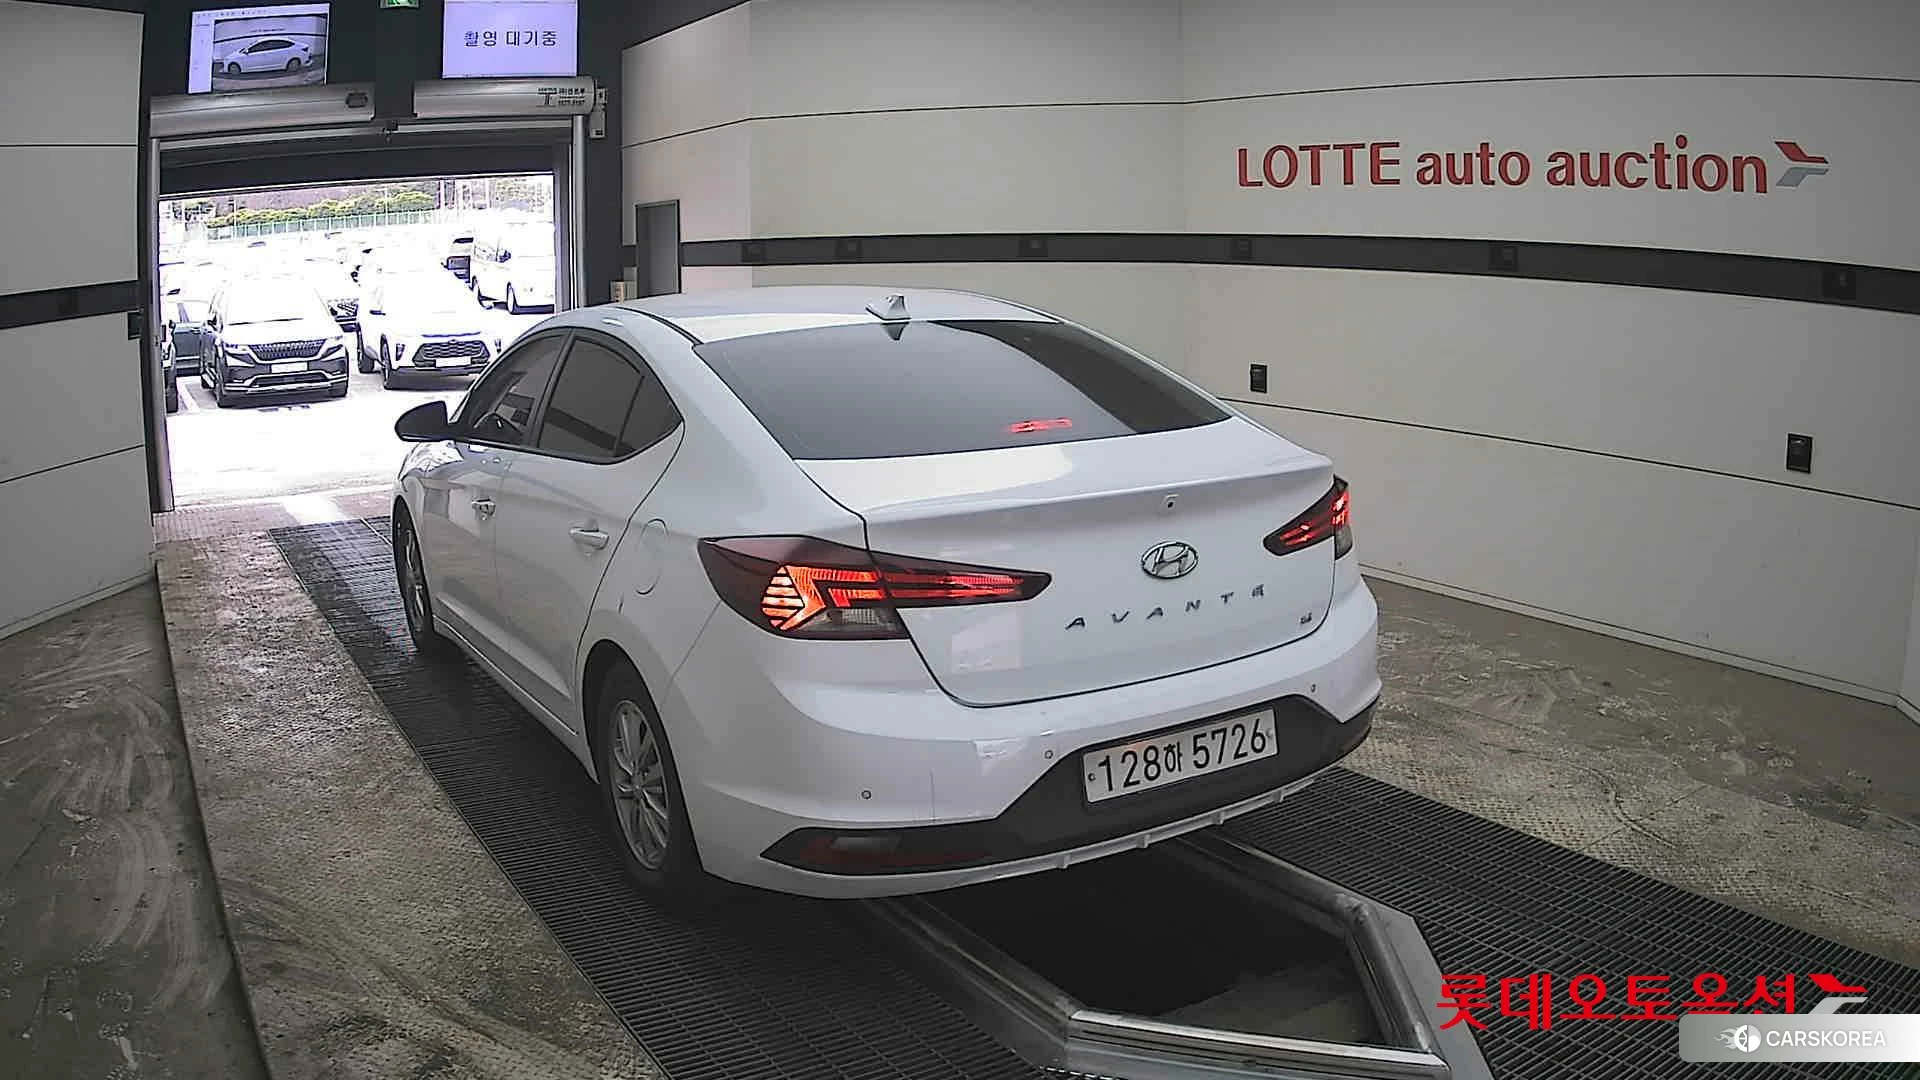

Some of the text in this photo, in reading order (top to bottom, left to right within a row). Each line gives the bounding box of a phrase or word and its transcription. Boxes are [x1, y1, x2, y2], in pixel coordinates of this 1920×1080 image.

[464, 30, 557, 47] 촬영 대기중
[1237, 134, 1767, 193] LOTTE auto auction
[1065, 584, 1265, 631] AVANTE
[1098, 718, 1267, 792] 128하 5726
